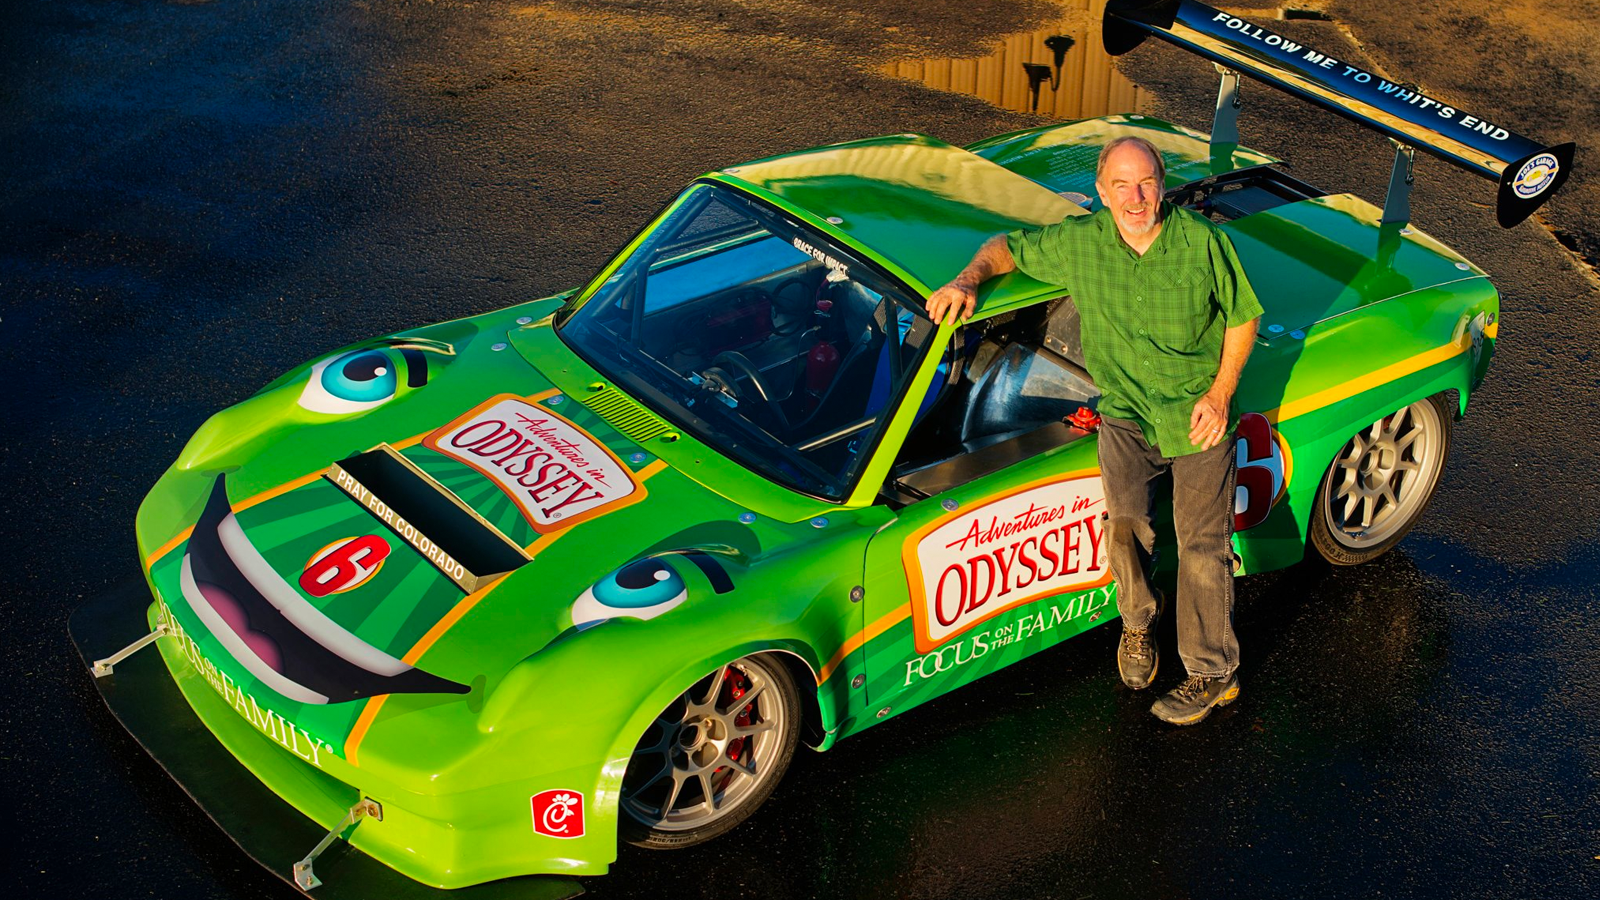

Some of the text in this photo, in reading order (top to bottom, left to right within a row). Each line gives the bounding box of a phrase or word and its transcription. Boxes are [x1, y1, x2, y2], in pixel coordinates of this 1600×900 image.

[1212, 12, 1510, 141] FOLLOW ME TO WHIT'S END
[812, 248, 826, 264] FOR
[825, 255, 849, 276] IMPACT
[450, 419, 605, 519] ODYSSEY
[515, 412, 612, 489] Adventures in
[300, 534, 391, 598] 6
[336, 469, 464, 580] PRAY FOR COLORADO
[945, 495, 1106, 551] Adventures in
[934, 508, 1109, 627] ODYSSEY
[204, 657, 219, 676] ON
[903, 582, 1118, 687] FOCUS ON THE FAMILY
[204, 667, 224, 696] THE
[220, 670, 324, 768] FAMILY
